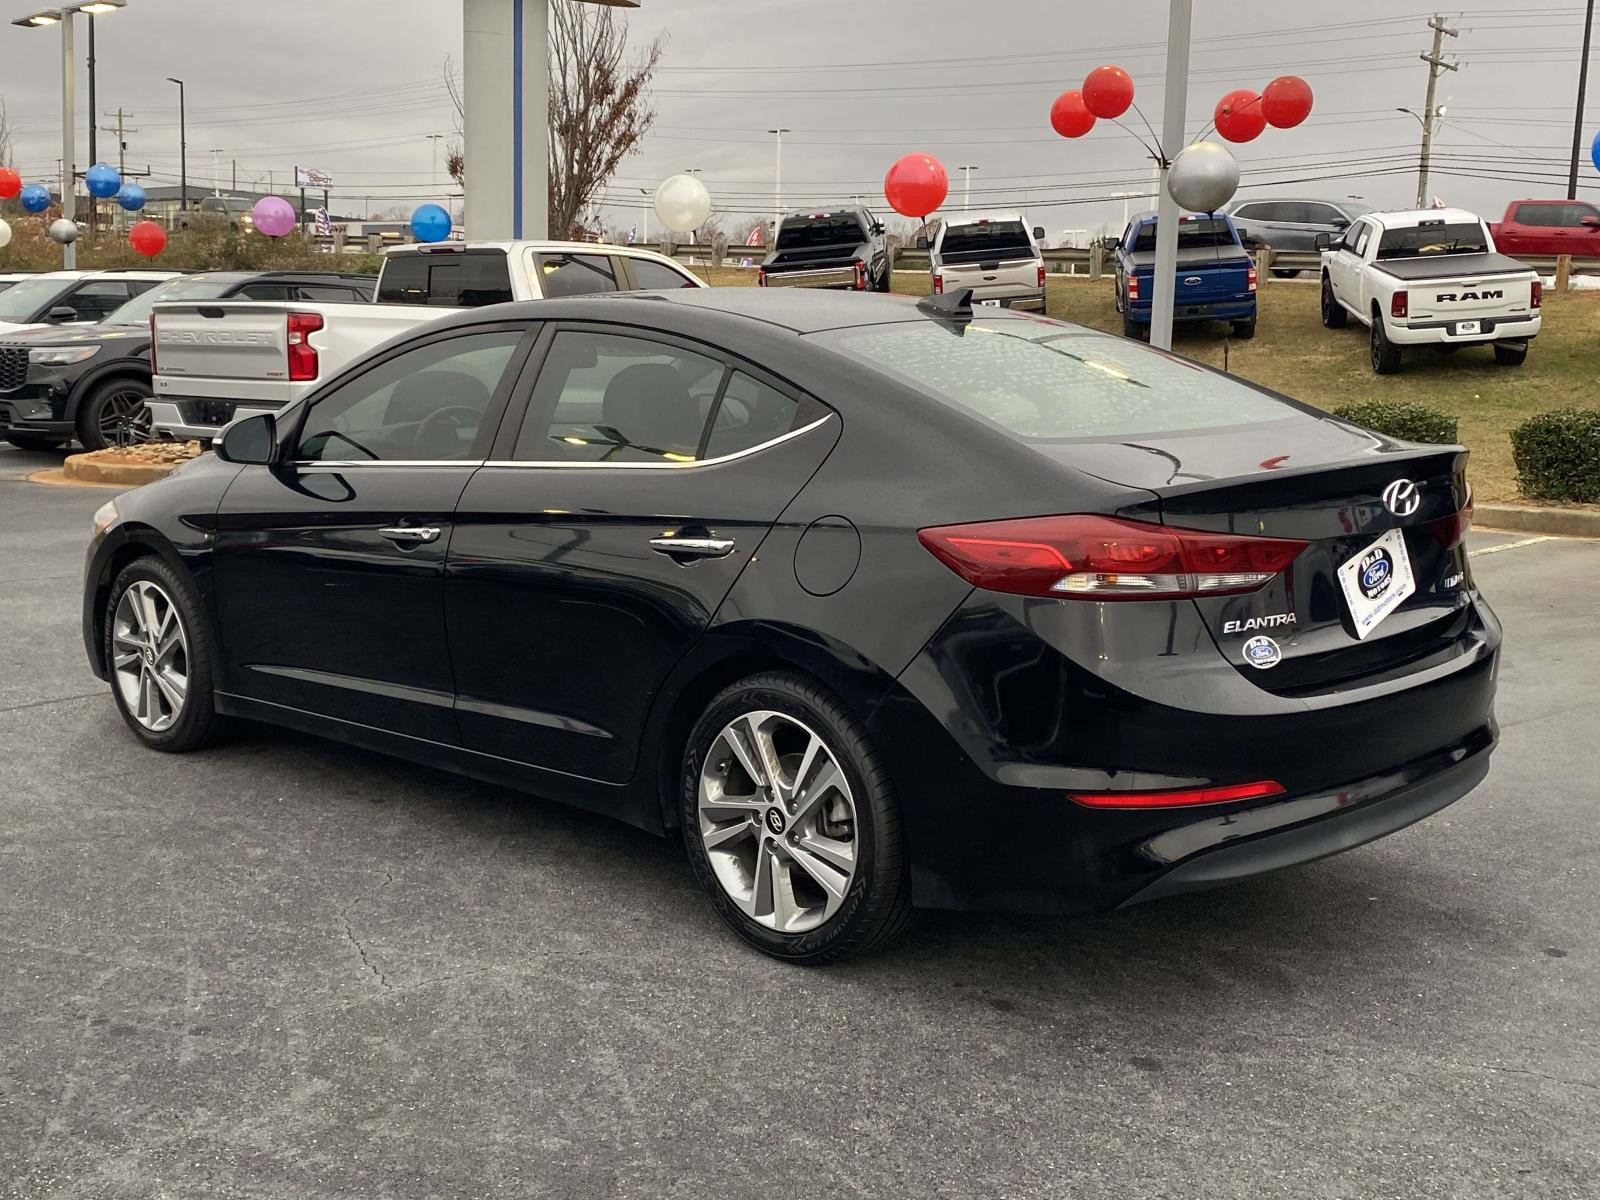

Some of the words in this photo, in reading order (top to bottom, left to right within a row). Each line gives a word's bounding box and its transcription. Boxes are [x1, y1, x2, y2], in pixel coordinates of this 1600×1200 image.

[309, 176, 332, 184] DEPOT
[1436, 290, 1503, 302] RAM
[160, 330, 274, 344] CHEVROLET
[1361, 548, 1384, 572] D&D
[1369, 564, 1386, 584] Ford
[1367, 573, 1392, 599] MOTORS
[1223, 612, 1297, 634] ELANTRA
